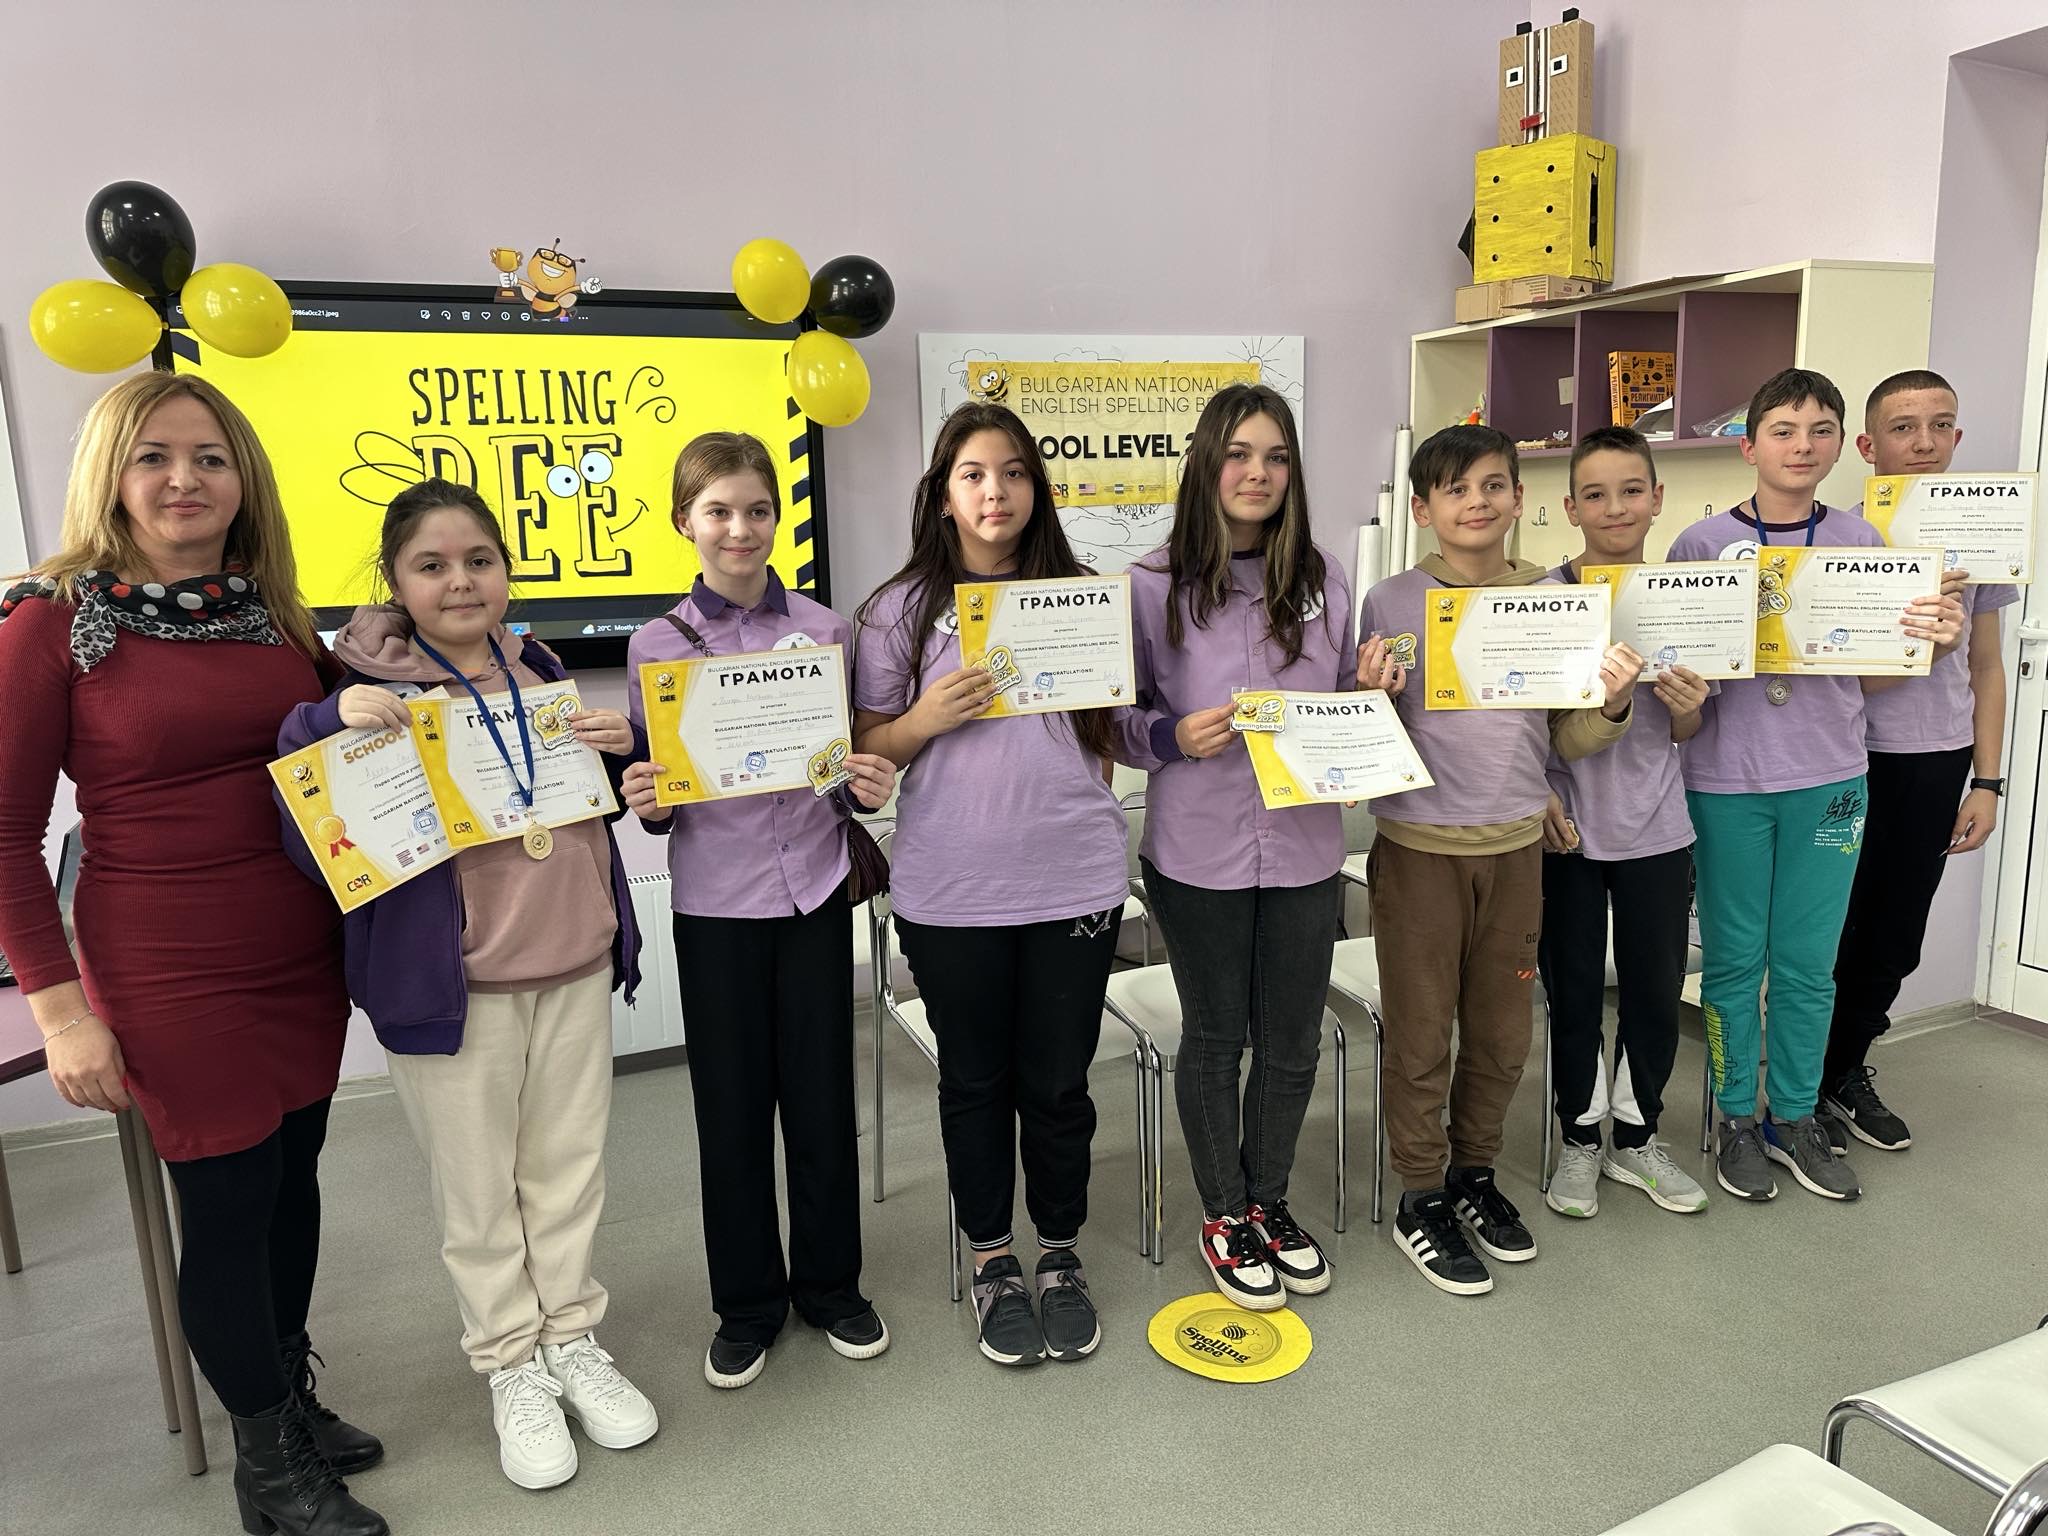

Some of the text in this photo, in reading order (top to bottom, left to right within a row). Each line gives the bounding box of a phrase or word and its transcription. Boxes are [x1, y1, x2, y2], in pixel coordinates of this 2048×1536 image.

[1020, 376, 1129, 393] BULGARIAN
[409, 367, 617, 426] SPELLING
[1021, 397, 1099, 414] ENGLISH
[1106, 396, 1189, 413] SPELLING
[1031, 434, 1097, 460] OOL
[1104, 434, 1180, 458] LEVEL
[1930, 486, 2019, 498] ГРАМОТА
[1825, 562, 1921, 574] ГРАМОТА
[1648, 575, 1739, 589] ГРАМОТА
[1020, 592, 1110, 610] ГРАМОТА
[1493, 600, 1589, 614] ГРАМОТА
[614, 623, 634, 632] Mostly
[708, 665, 740, 673] BULGARIAN
[720, 664, 823, 687] ГРАМОТА
[1041, 668, 1094, 676] CONGRATULATIONS!
[659, 693, 677, 703] BEE
[1296, 703, 1375, 716] ГРАМОТА
[715, 725, 743, 733] BULGARIAN
[743, 722, 768, 730] NATIONAL
[768, 719, 789, 727] ENGLISH
[789, 716, 811, 724] SPELLING
[340, 731, 372, 751] BULGARIAN
[748, 744, 807, 757] CONGRATULATIONS!
[302, 785, 321, 799] BEE
[373, 803, 403, 821] BULGARIAN
[403, 790, 430, 806] NATIONAL
[1182, 1326, 1251, 1364] Spelling
[1189, 1340, 1224, 1358] Bee
